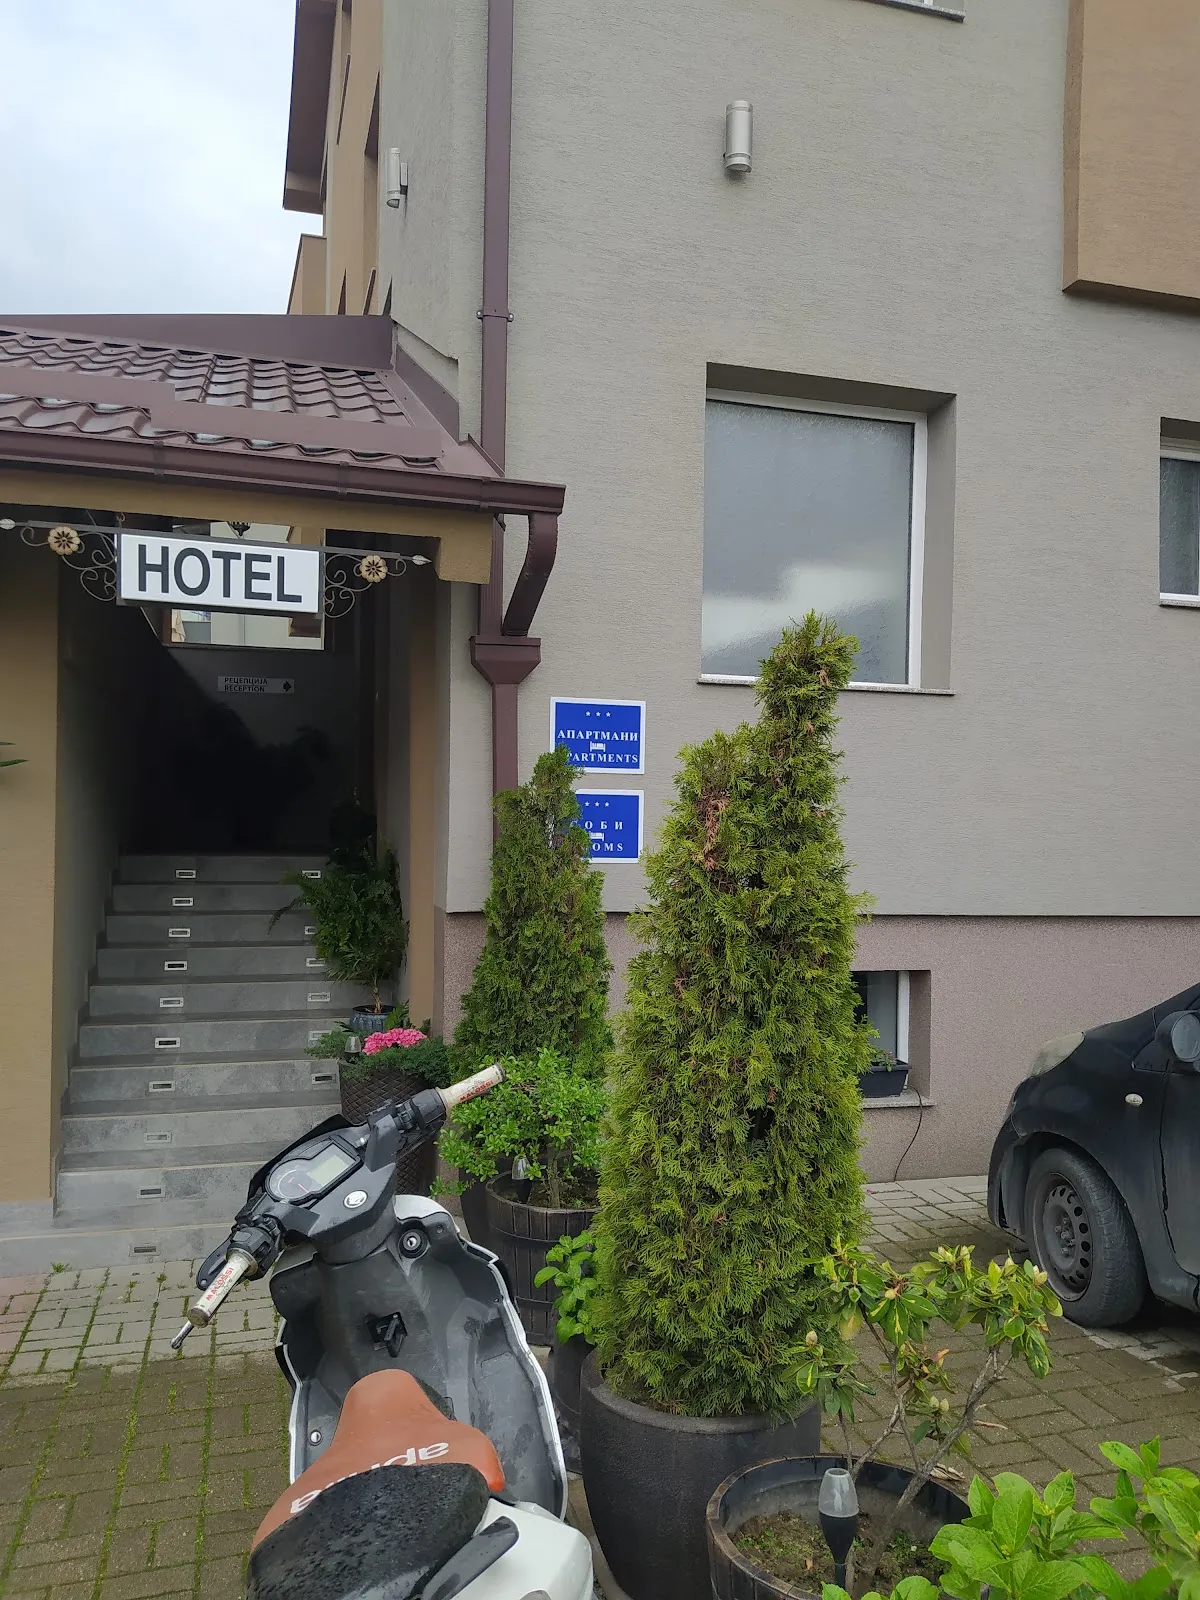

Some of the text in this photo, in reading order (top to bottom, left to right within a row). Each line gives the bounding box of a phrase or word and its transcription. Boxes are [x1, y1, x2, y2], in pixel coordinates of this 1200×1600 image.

[138, 544, 303, 604] HOTEL
[224, 677, 268, 686] РЕЦЕПЦИЈА
[224, 685, 265, 693] RECEPTION
[557, 729, 639, 742] АПАРТМАНИ
[567, 752, 639, 764] PARTMENTS
